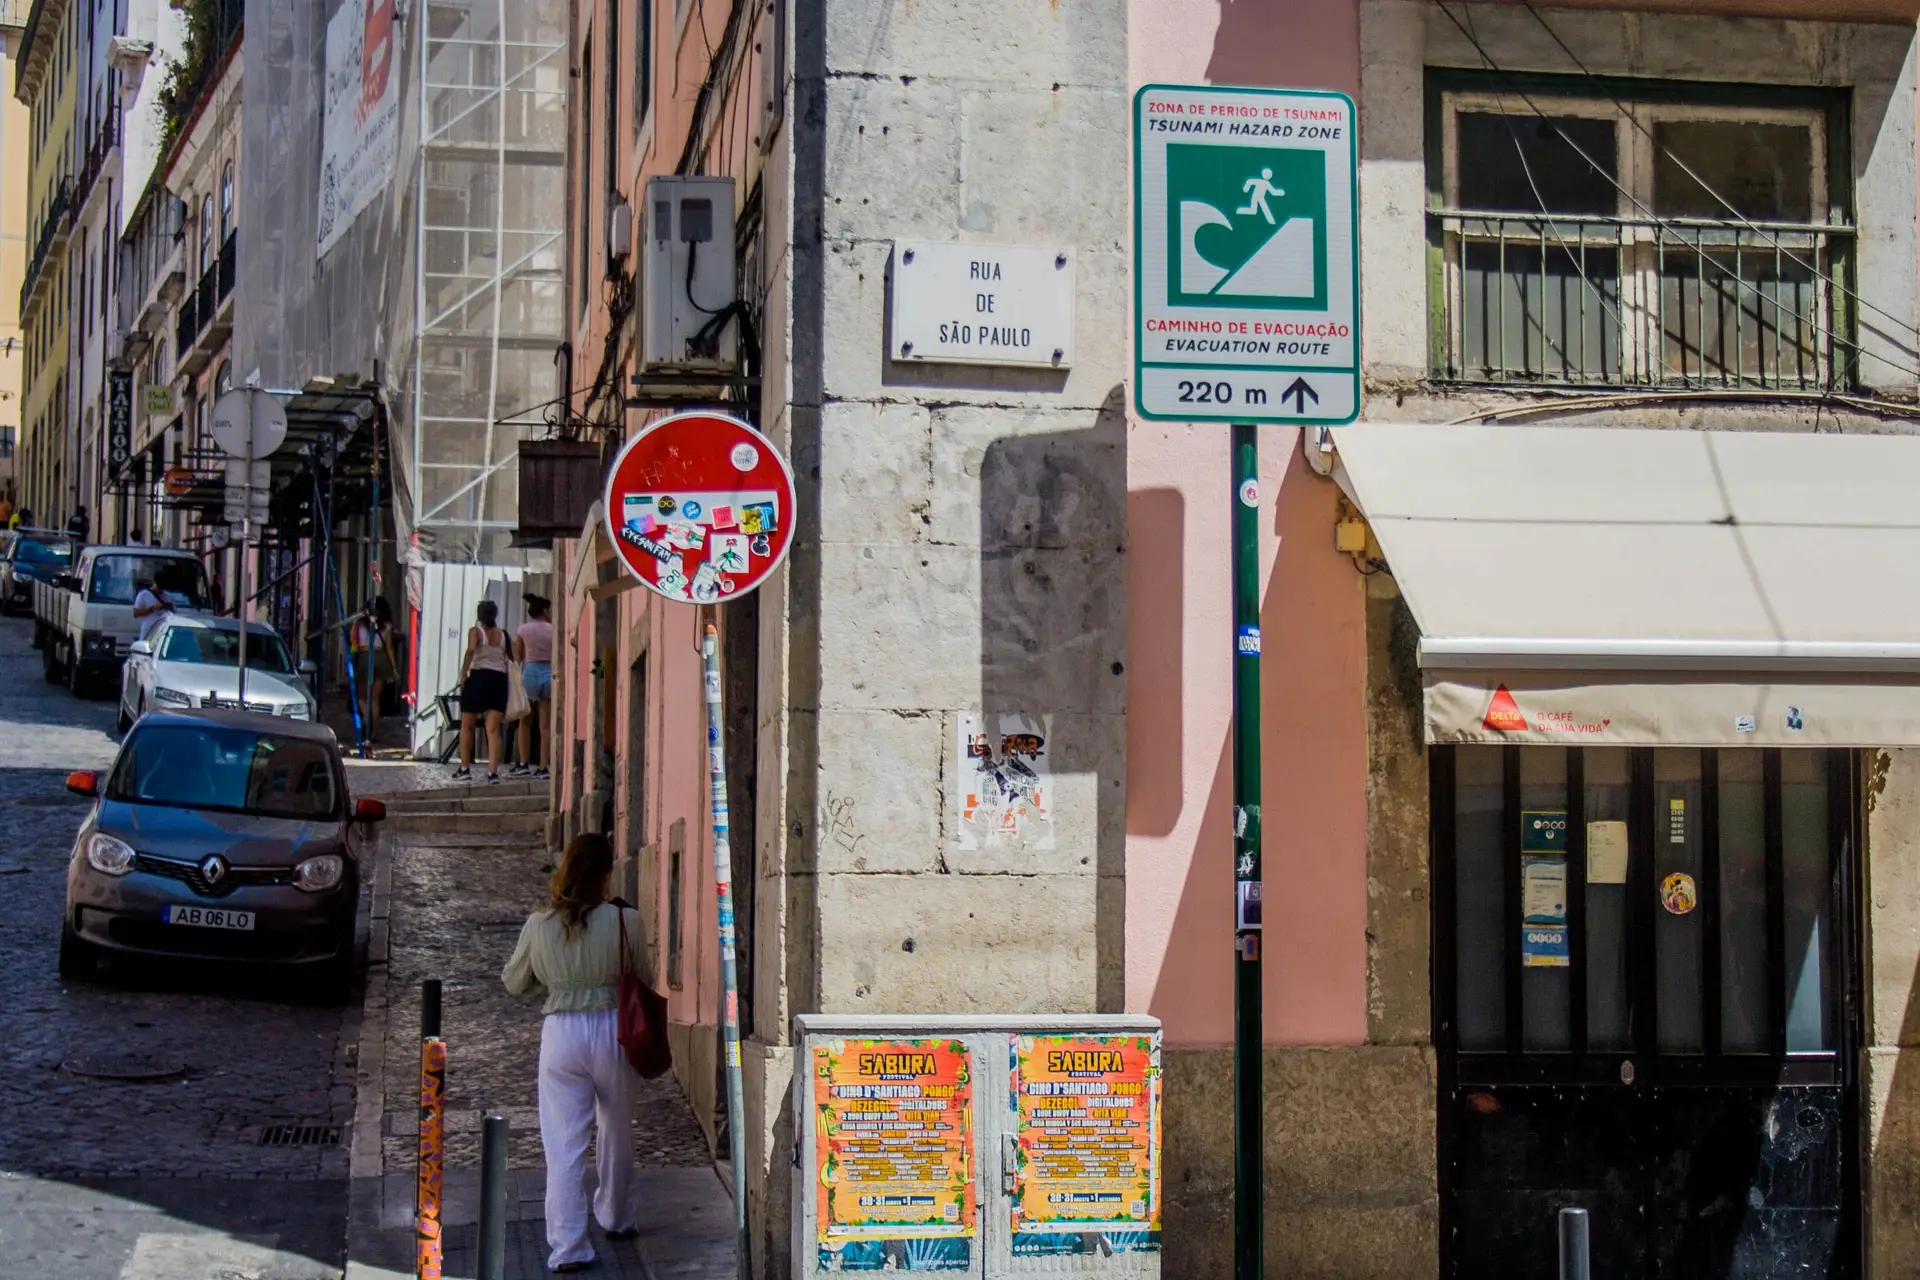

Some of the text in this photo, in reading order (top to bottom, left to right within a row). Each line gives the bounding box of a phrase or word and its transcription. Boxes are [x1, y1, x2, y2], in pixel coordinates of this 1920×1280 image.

[1148, 102, 1343, 121] ZONA DE PERIGO DE TSUNAMI
[1148, 120, 1342, 140] TSUNAMI HAZARD ZONE
[970, 261, 1002, 281] RUA
[976, 293, 995, 313] DE
[939, 320, 1031, 347] SÃO PAULO
[1146, 319, 1349, 340] CAMINHO DE EVACUAÇÃO
[1165, 339, 1331, 355] EVACUATION ROUTE
[1178, 381, 1267, 405] 220 m
[112, 376, 129, 462] TATTOO
[1490, 711, 1520, 721] DELTA
[1537, 711, 1573, 721] O CAFÉ
[1538, 724, 1603, 733] DA SUA VIDA
[176, 908, 249, 928] AB 06 LO
[860, 1054, 936, 1075] SABURA
[1048, 1051, 1123, 1072] SABURA
[840, 1085, 955, 1098] DINO D'SANTIAGO PONGO
[1053, 1083, 1108, 1095] D'SANTIAGO
[1110, 1083, 1142, 1095] PONGO
